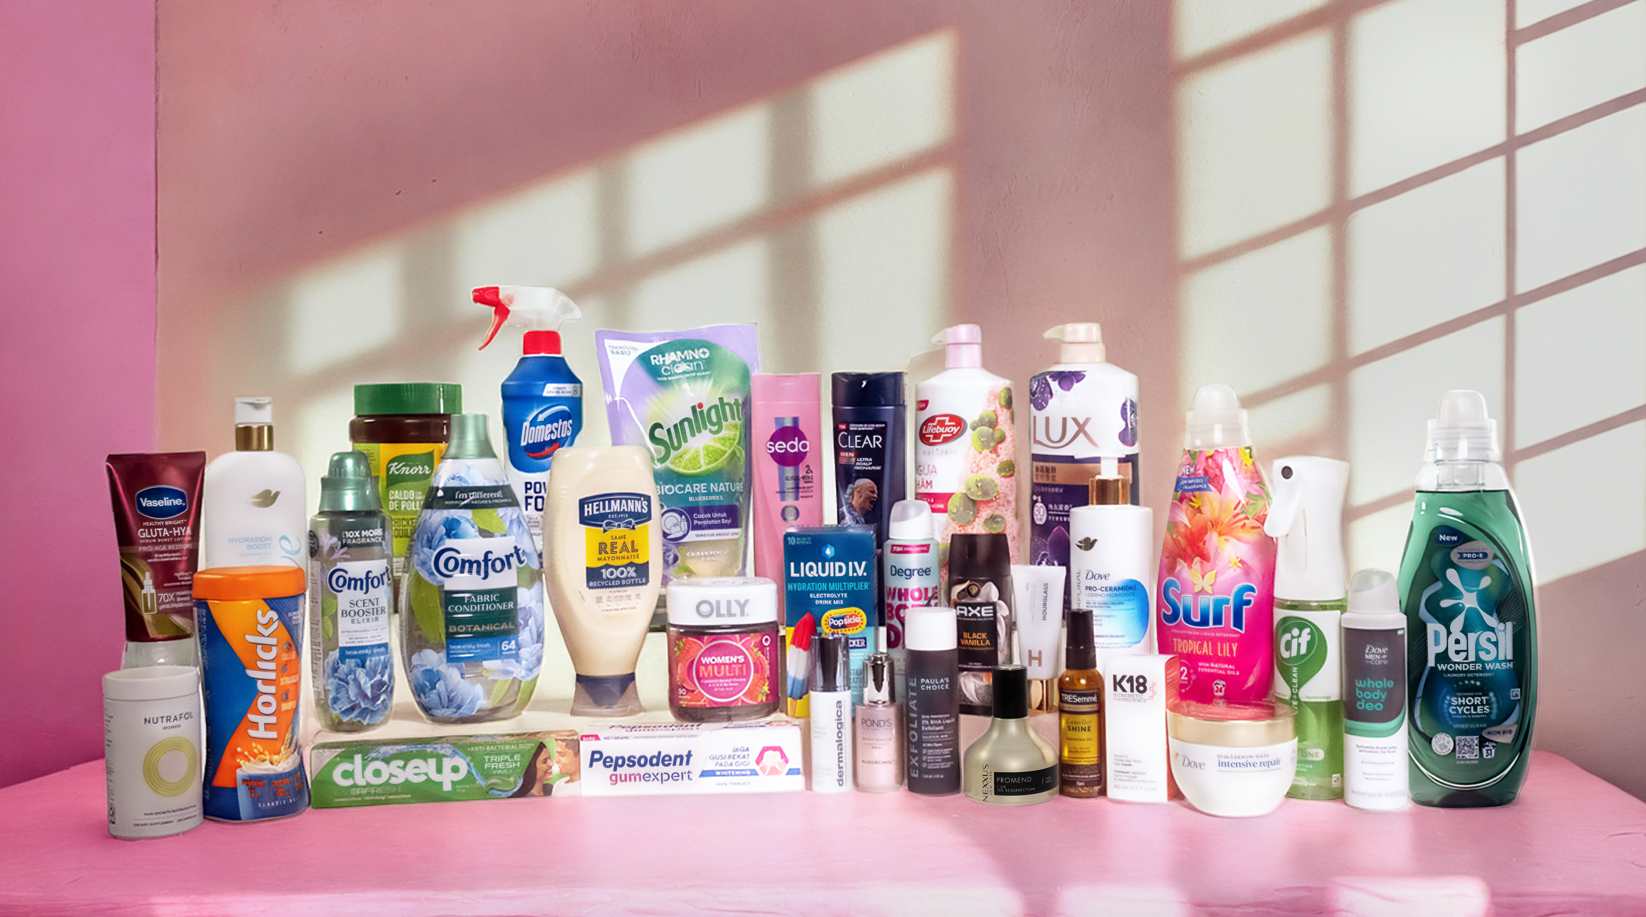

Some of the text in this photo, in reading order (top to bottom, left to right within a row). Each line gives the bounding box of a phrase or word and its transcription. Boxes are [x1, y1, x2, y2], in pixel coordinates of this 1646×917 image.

[661, 360, 704, 375] clean
[520, 418, 573, 446] Domestos
[648, 397, 743, 467] Sunlight
[922, 425, 960, 435] Lifebuoy
[1032, 415, 1100, 449] LUX
[766, 437, 810, 453] seda
[838, 431, 882, 449] CLEAR
[387, 462, 432, 475] Knorr
[654, 481, 744, 495] BIOCARE NATURE
[389, 490, 414, 500] CALDO
[139, 497, 183, 507] Vaseline
[389, 500, 400, 511] DE
[584, 496, 648, 517] HELLMANN'S
[137, 527, 192, 538] GLUTA-HYA
[344, 528, 383, 538] 10X MORE
[1439, 533, 1459, 542] New
[228, 536, 272, 544] HYDRATION
[342, 536, 382, 545] FRAGRANCE
[787, 536, 796, 545] 10
[246, 542, 272, 550] BOOST
[598, 540, 639, 555] REAL
[432, 545, 526, 580] Comfort
[597, 554, 640, 562] MAYONNAISE
[600, 566, 636, 579] 100%
[790, 561, 867, 578] LIQUID I.V.
[890, 564, 931, 580] Degree
[1085, 569, 1111, 581] Dove
[328, 565, 391, 594] Comfort
[589, 577, 646, 587] RECYCLED BOTTLE
[787, 581, 869, 591] HYDRATION MULTIPLIER
[157, 592, 175, 603] 70X
[464, 594, 500, 603] FABRIC
[885, 586, 939, 602] WHOLE
[349, 598, 380, 608] SCENT
[447, 602, 515, 613] CONDITIONER
[695, 598, 751, 619] OLLY
[1161, 577, 1258, 633] Surf
[340, 606, 387, 619] BOOSTER
[956, 605, 994, 617] AXE
[350, 616, 380, 625] ELIXIR
[828, 616, 861, 628] Popsicle
[448, 622, 516, 633] BOTANICAL
[963, 632, 987, 640] BLACK
[501, 640, 516, 651] 64
[960, 638, 991, 647] VANILLA
[1172, 638, 1239, 657] TROPICAL LILY
[1280, 627, 1311, 659] Cif
[1427, 621, 1514, 667] Persil
[1365, 645, 1389, 655] Dove
[700, 655, 745, 665] WOMEN'S
[1027, 650, 1043, 668] H
[699, 664, 747, 678] MULTI
[1198, 667, 1226, 675] ESSENTIAL
[1437, 662, 1514, 671] WONDER WASH
[244, 609, 279, 739] Horlicks
[920, 683, 950, 691] CHOICE
[1112, 674, 1148, 694] K18
[1355, 678, 1394, 689] whole
[1061, 693, 1098, 704] TRESemmé
[1356, 688, 1388, 702] body
[1356, 699, 1384, 712] deo
[1451, 696, 1488, 706] SHORT
[1449, 705, 1490, 715] CYCLES
[143, 711, 194, 725] NUTRAFOL
[861, 718, 893, 728] POND'S
[908, 677, 919, 778] EXFOLIATE
[1067, 725, 1092, 733] SHINE
[469, 744, 519, 752] ANTI-BACTERIAL
[835, 700, 845, 787] dermalogica
[1301, 751, 1320, 759] ONE
[1485, 748, 1493, 756] 31
[483, 754, 521, 763] TRIPLE
[588, 749, 694, 772] Pepsodent
[1182, 755, 1206, 770] Dove
[1218, 757, 1281, 769] intensive repair
[484, 762, 520, 770] FRESH
[332, 754, 469, 792] closeup
[609, 770, 694, 786] gumexpert
[982, 763, 990, 803] NEXXUS
[996, 776, 1033, 784] PROMEND
